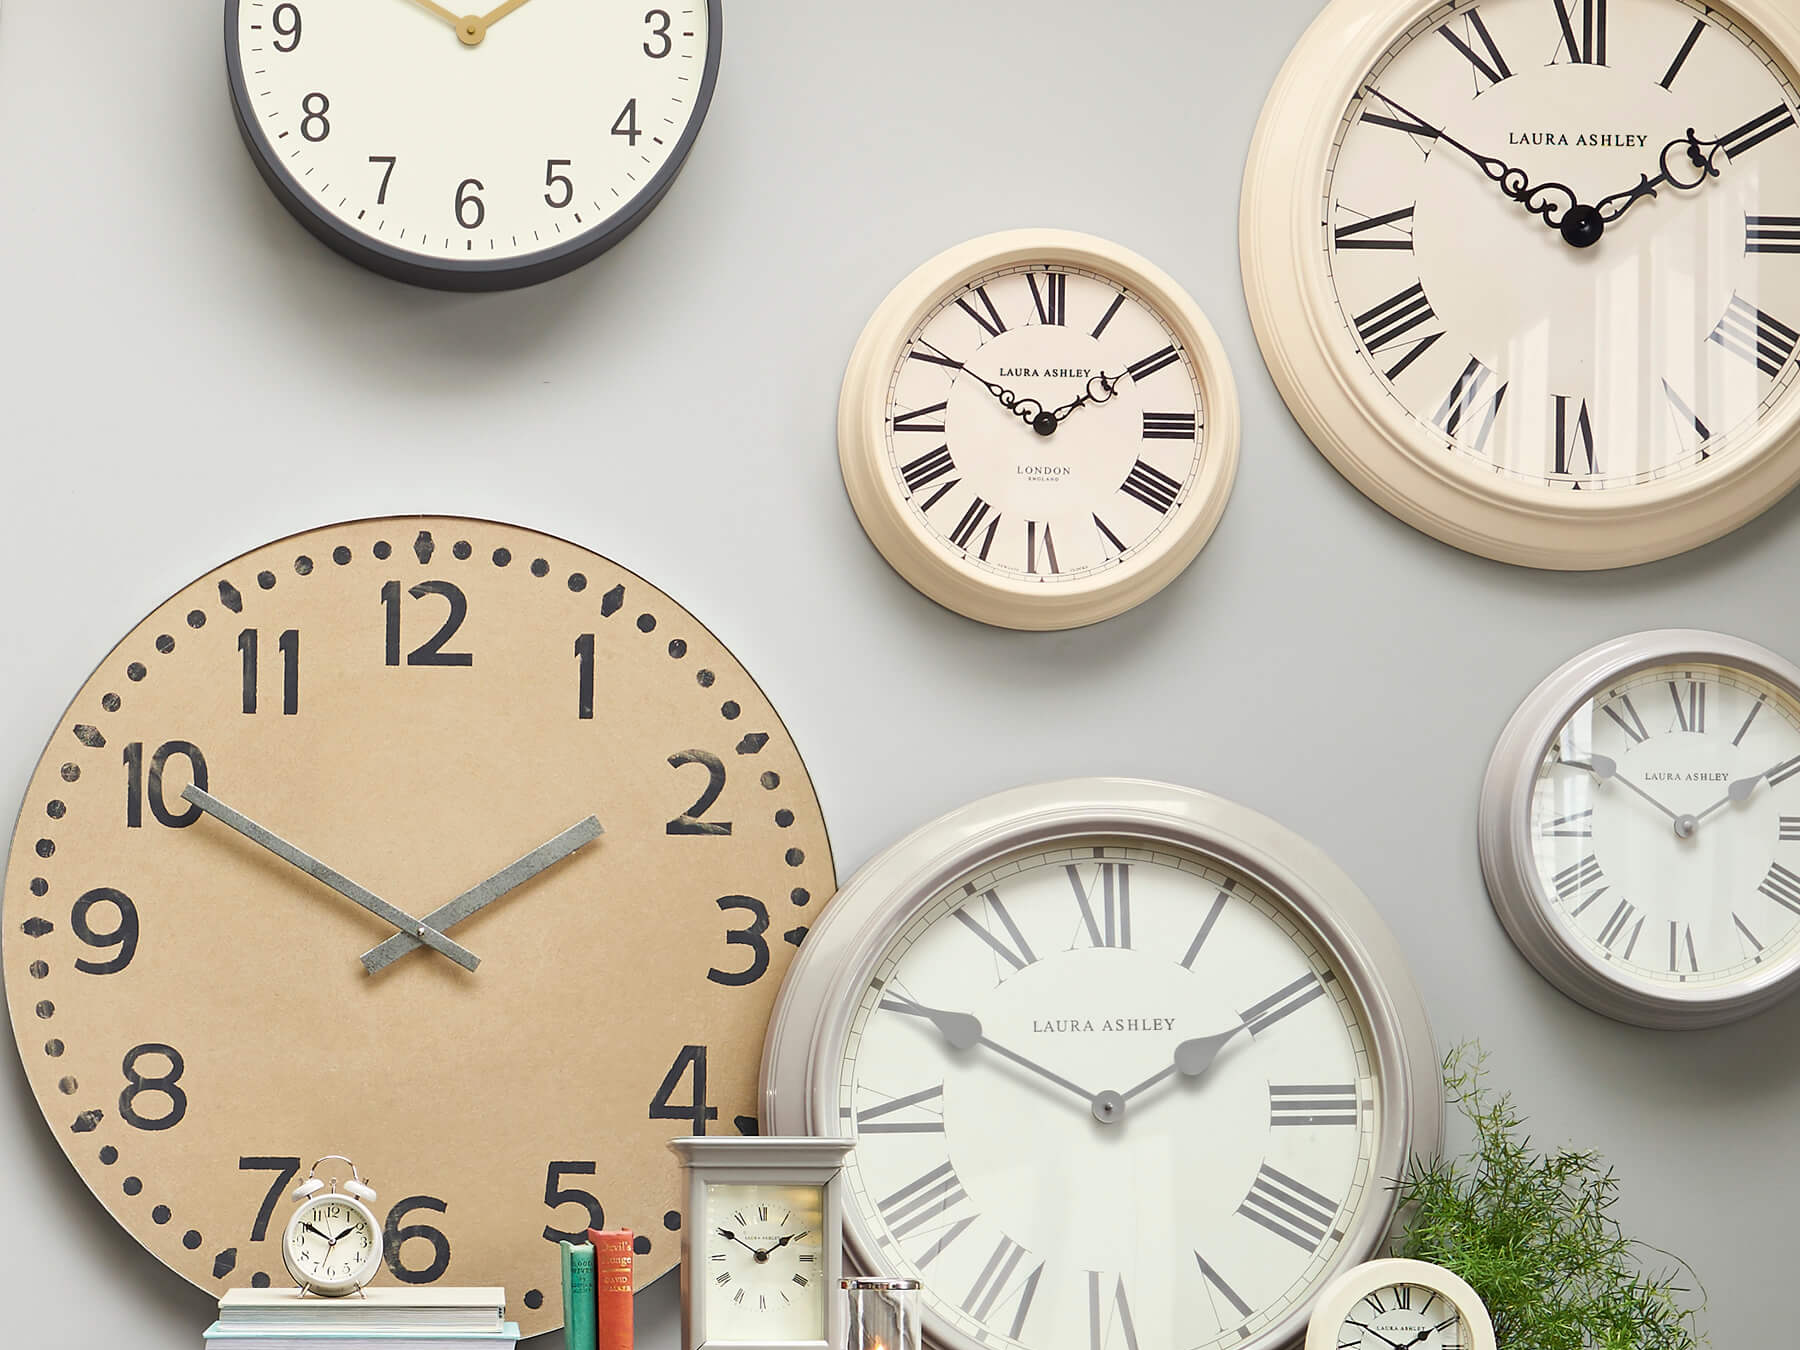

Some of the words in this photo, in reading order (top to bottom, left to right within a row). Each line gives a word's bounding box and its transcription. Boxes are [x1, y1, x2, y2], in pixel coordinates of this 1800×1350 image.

[272, 3, 302, 53] 9
[643, 9, 673, 59] 3
[300, 92, 330, 142] 8
[610, 98, 642, 146] 4
[1509, 131, 1569, 146] LAURA
[1575, 132, 1649, 149] ASHLEY
[368, 156, 397, 205] 7
[454, 178, 486, 230] 6
[544, 159, 573, 209] 5
[999, 367, 1040, 378] LAURA
[1043, 368, 1092, 379] ASHLEY
[1016, 465, 1072, 476] LONDON
[380, 579, 474, 668] 12
[237, 628, 300, 715] 11
[573, 632, 595, 720] 1
[122, 740, 210, 830] 10
[664, 748, 733, 836] 2
[1644, 772, 1681, 781] LAURA
[1685, 772, 1729, 782] ASHLEY
[70, 886, 141, 976] 9
[706, 893, 771, 987] 3
[1032, 1019, 1094, 1034] LAURA
[1101, 1018, 1176, 1033] ASHLEY
[117, 1041, 188, 1131] 8
[647, 1044, 719, 1136] 4
[238, 1156, 301, 1243] 7
[541, 1160, 606, 1245] 5
[383, 1195, 450, 1285] 6
